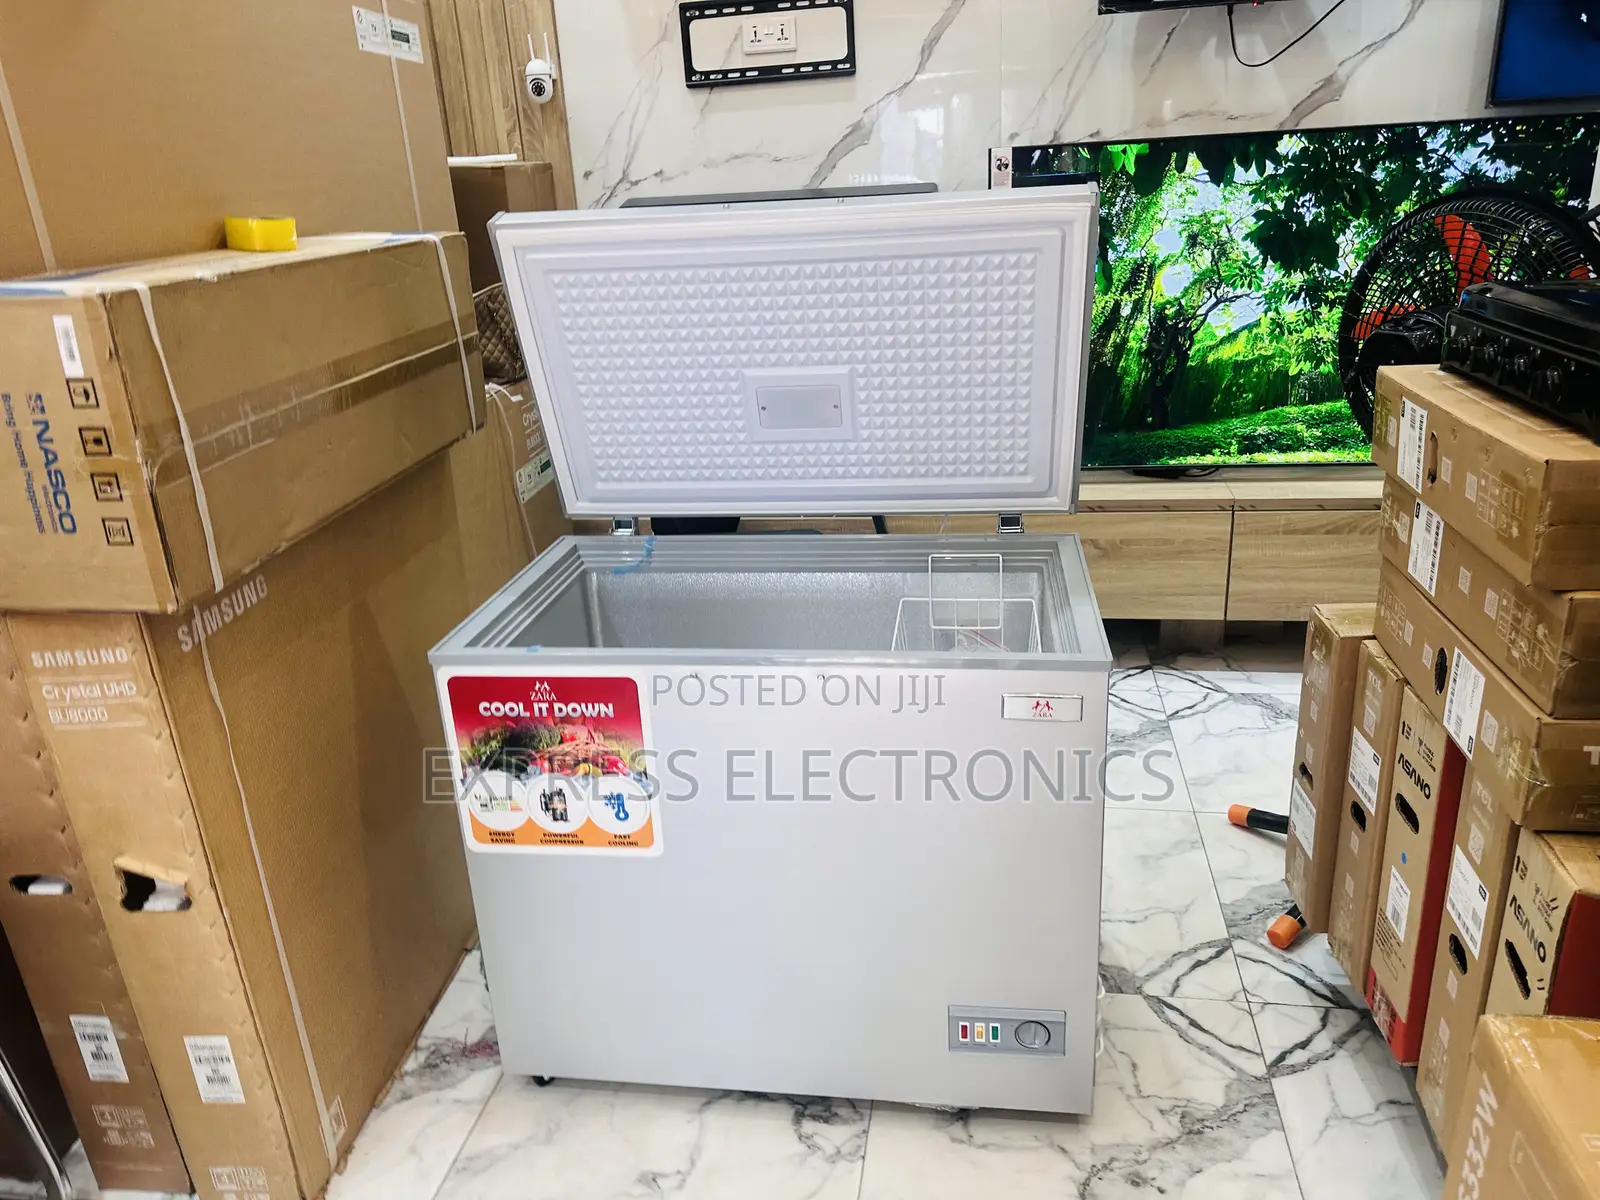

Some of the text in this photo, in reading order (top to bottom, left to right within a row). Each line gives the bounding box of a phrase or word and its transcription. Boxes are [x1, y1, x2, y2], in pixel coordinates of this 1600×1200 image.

[32, 418, 77, 535] NASCO
[177, 574, 268, 653] SAMSUNG
[31, 646, 129, 669] SAMSUNG
[42, 680, 137, 704] Crystal UHD
[478, 701, 615, 718] COOL IT DOWN
[529, 691, 557, 701] ZARA
[1397, 752, 1431, 800] ASANO
[1509, 894, 1547, 963] ASANO
